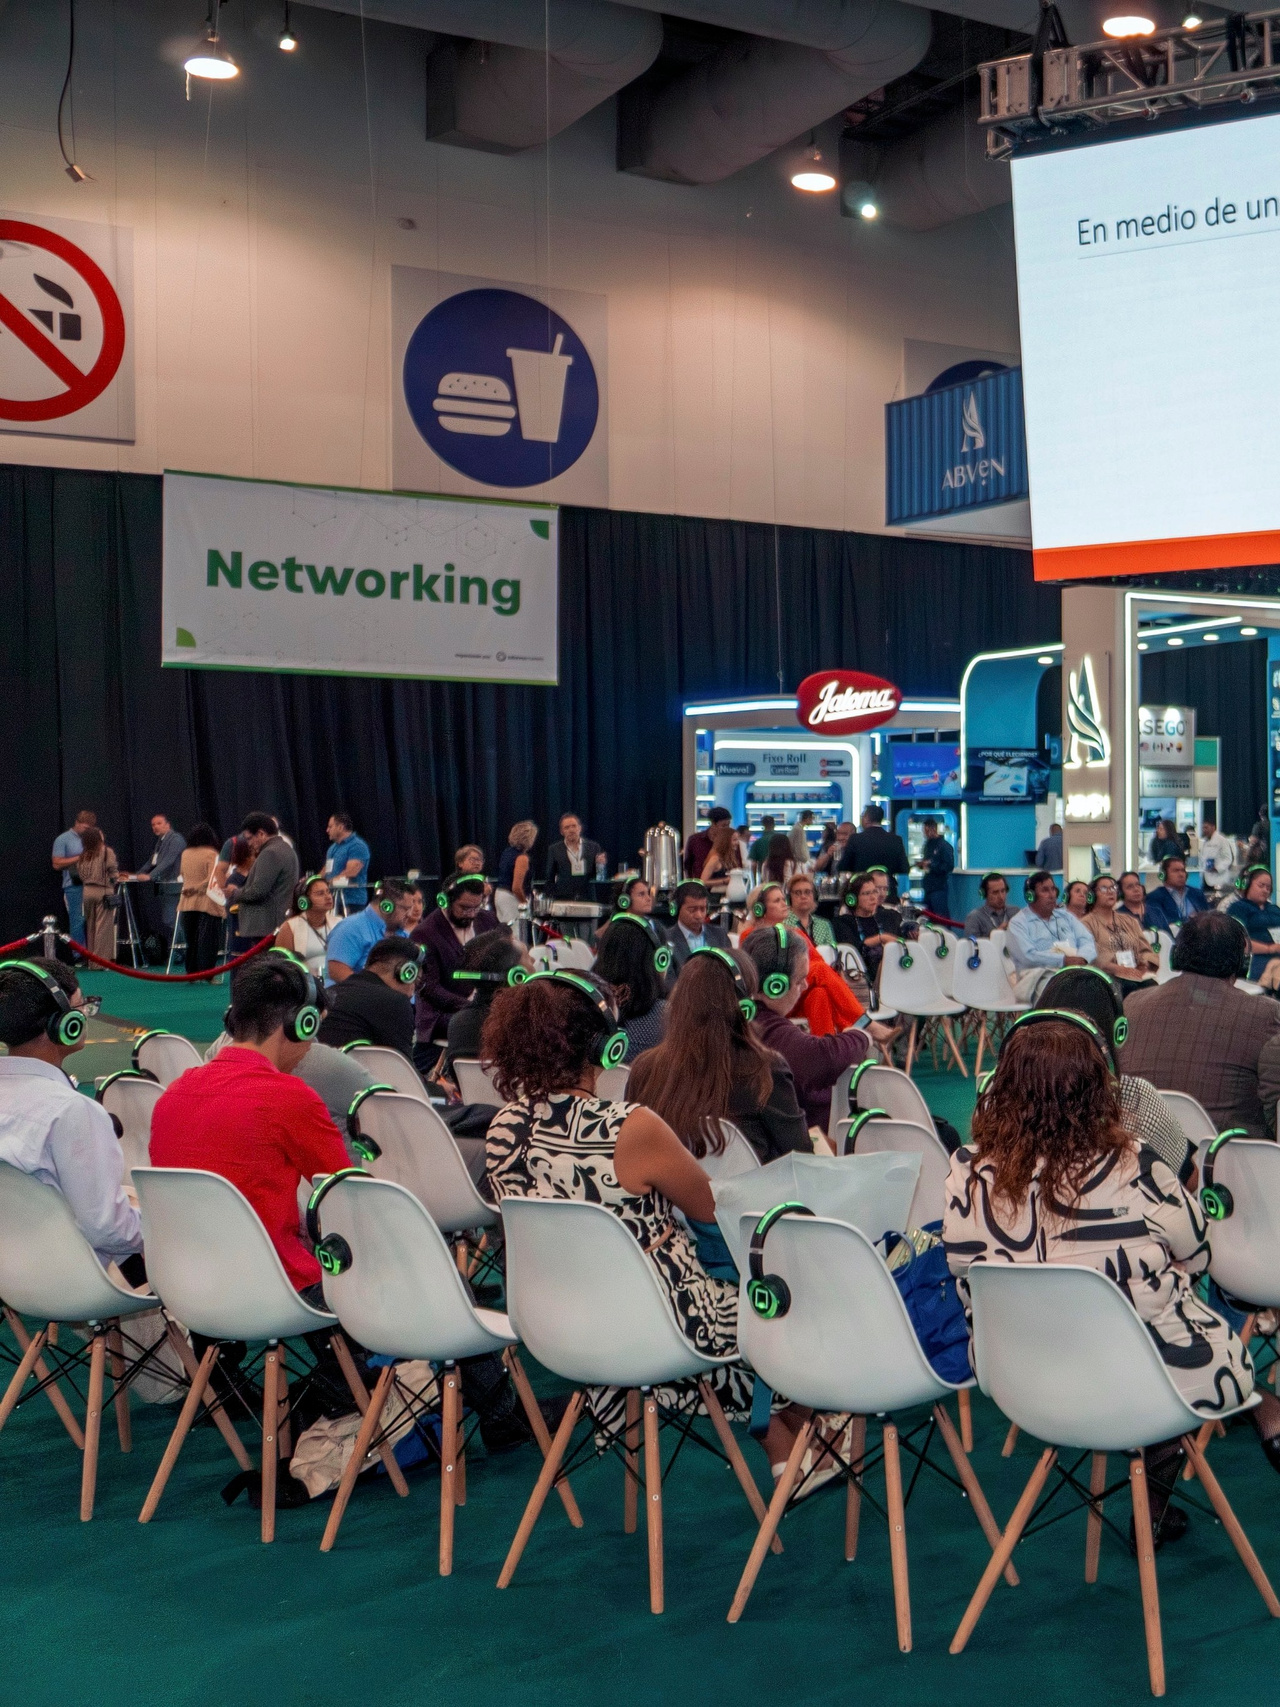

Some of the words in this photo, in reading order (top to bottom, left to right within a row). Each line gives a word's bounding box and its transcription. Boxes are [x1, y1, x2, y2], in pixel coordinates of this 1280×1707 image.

[1077, 218, 1107, 246] En
[1116, 204, 1196, 241] medio
[1205, 197, 1236, 227] de
[206, 548, 522, 617] Networking
[808, 680, 896, 725] Jaloma
[1139, 719, 1185, 737] SEGO
[762, 753, 784, 763] Fixo
[787, 753, 806, 763] Roll
